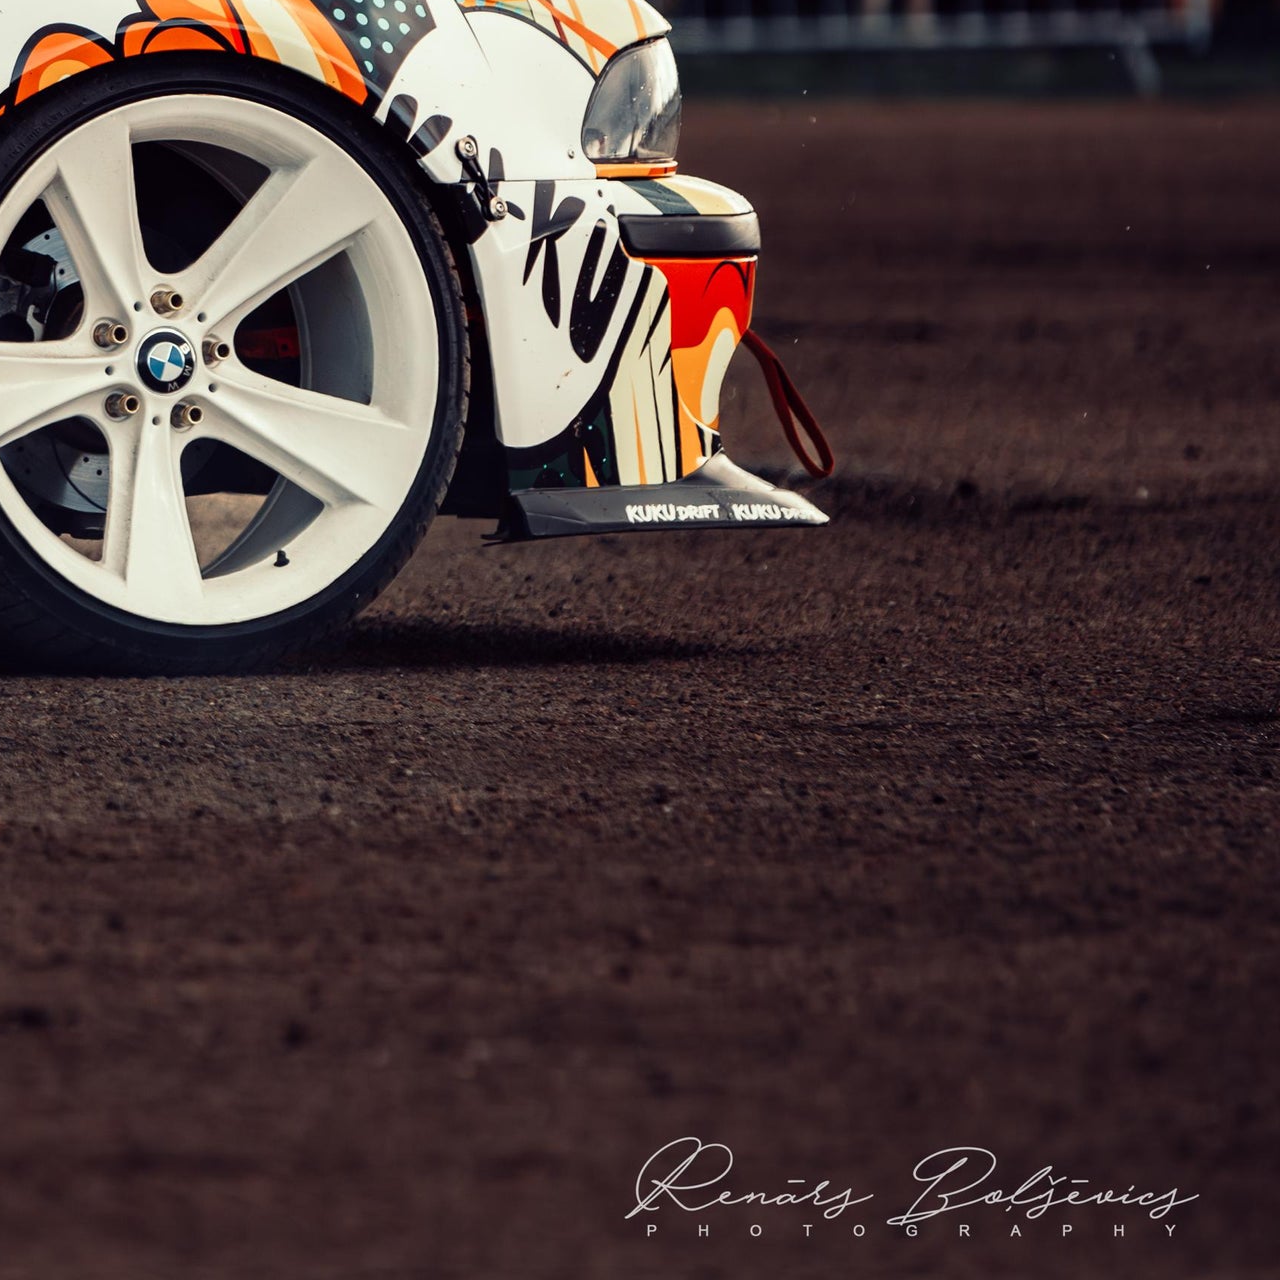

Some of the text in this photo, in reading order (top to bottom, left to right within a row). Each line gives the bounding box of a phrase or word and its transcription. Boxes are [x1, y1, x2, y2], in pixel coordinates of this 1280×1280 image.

[625, 503, 720, 524] KUKU DRIFT
[731, 503, 782, 521] KUKU
